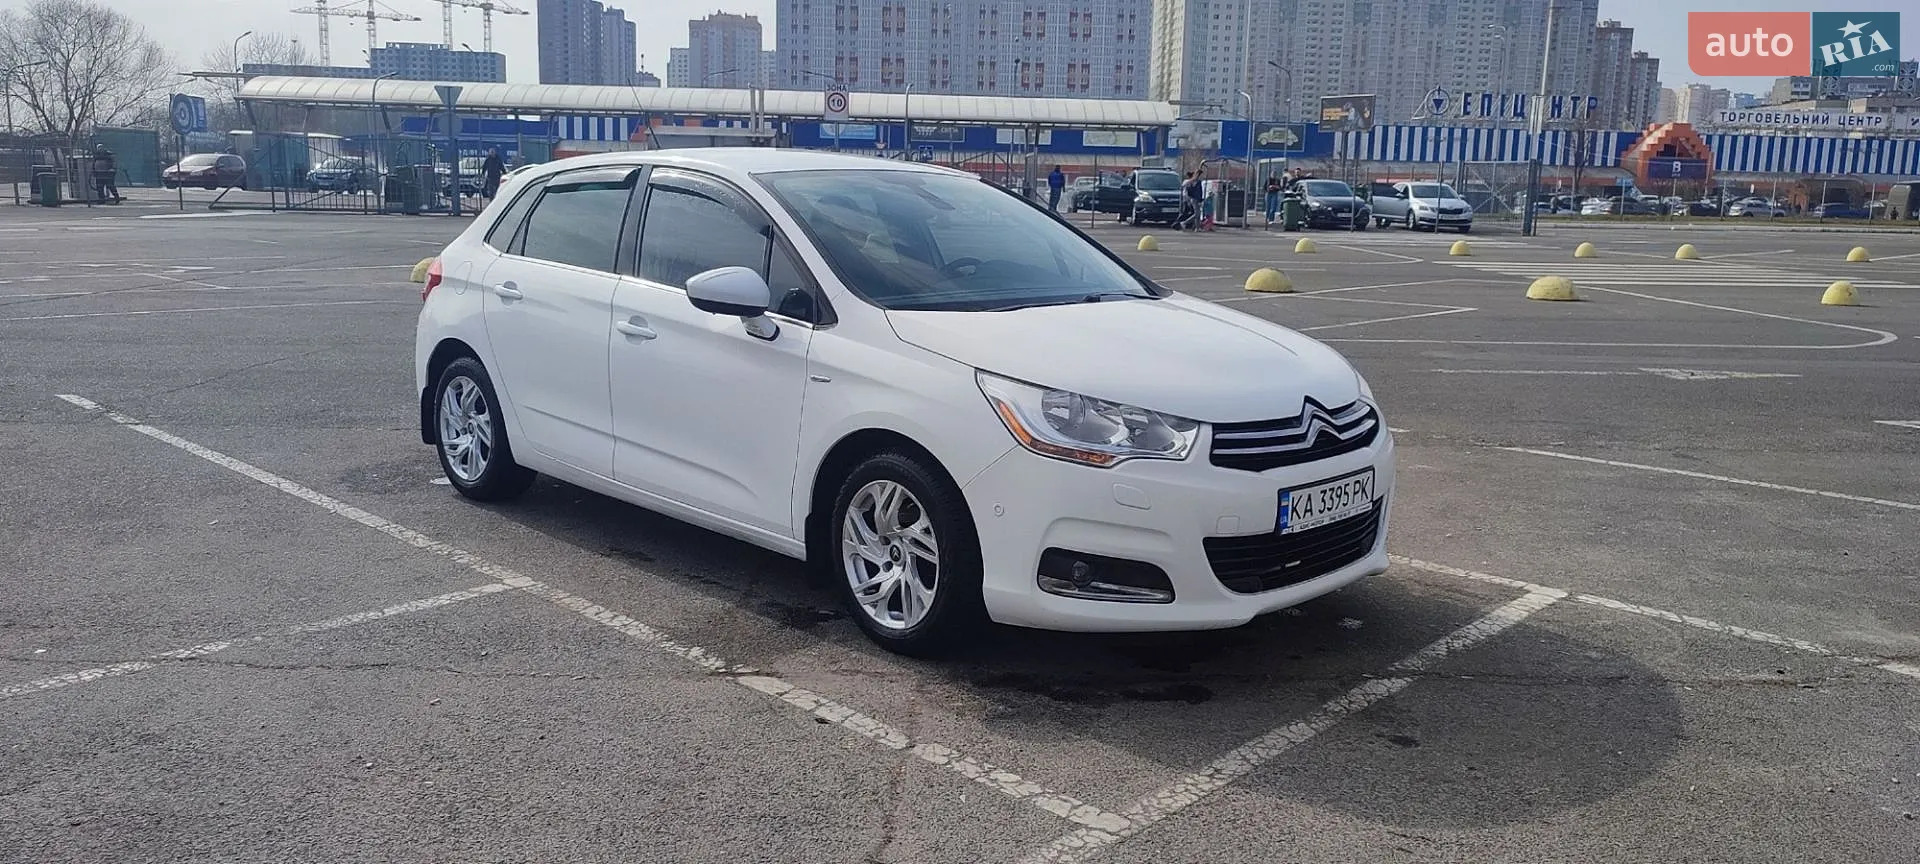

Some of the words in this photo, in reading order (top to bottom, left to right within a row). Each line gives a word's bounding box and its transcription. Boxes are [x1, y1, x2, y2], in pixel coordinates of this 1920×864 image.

[826, 84, 848, 92] ЗОНА
[831, 99, 843, 108] 10
[1461, 92, 1598, 120] ЕПІЦНТР
[1720, 111, 1830, 126] ТОРГОВЕЛЬНИЙ
[1838, 115, 1883, 128] ЦЕНТР
[1290, 492, 1314, 521] KA
[1318, 482, 1350, 514] 3395
[1352, 475, 1371, 505] PK
